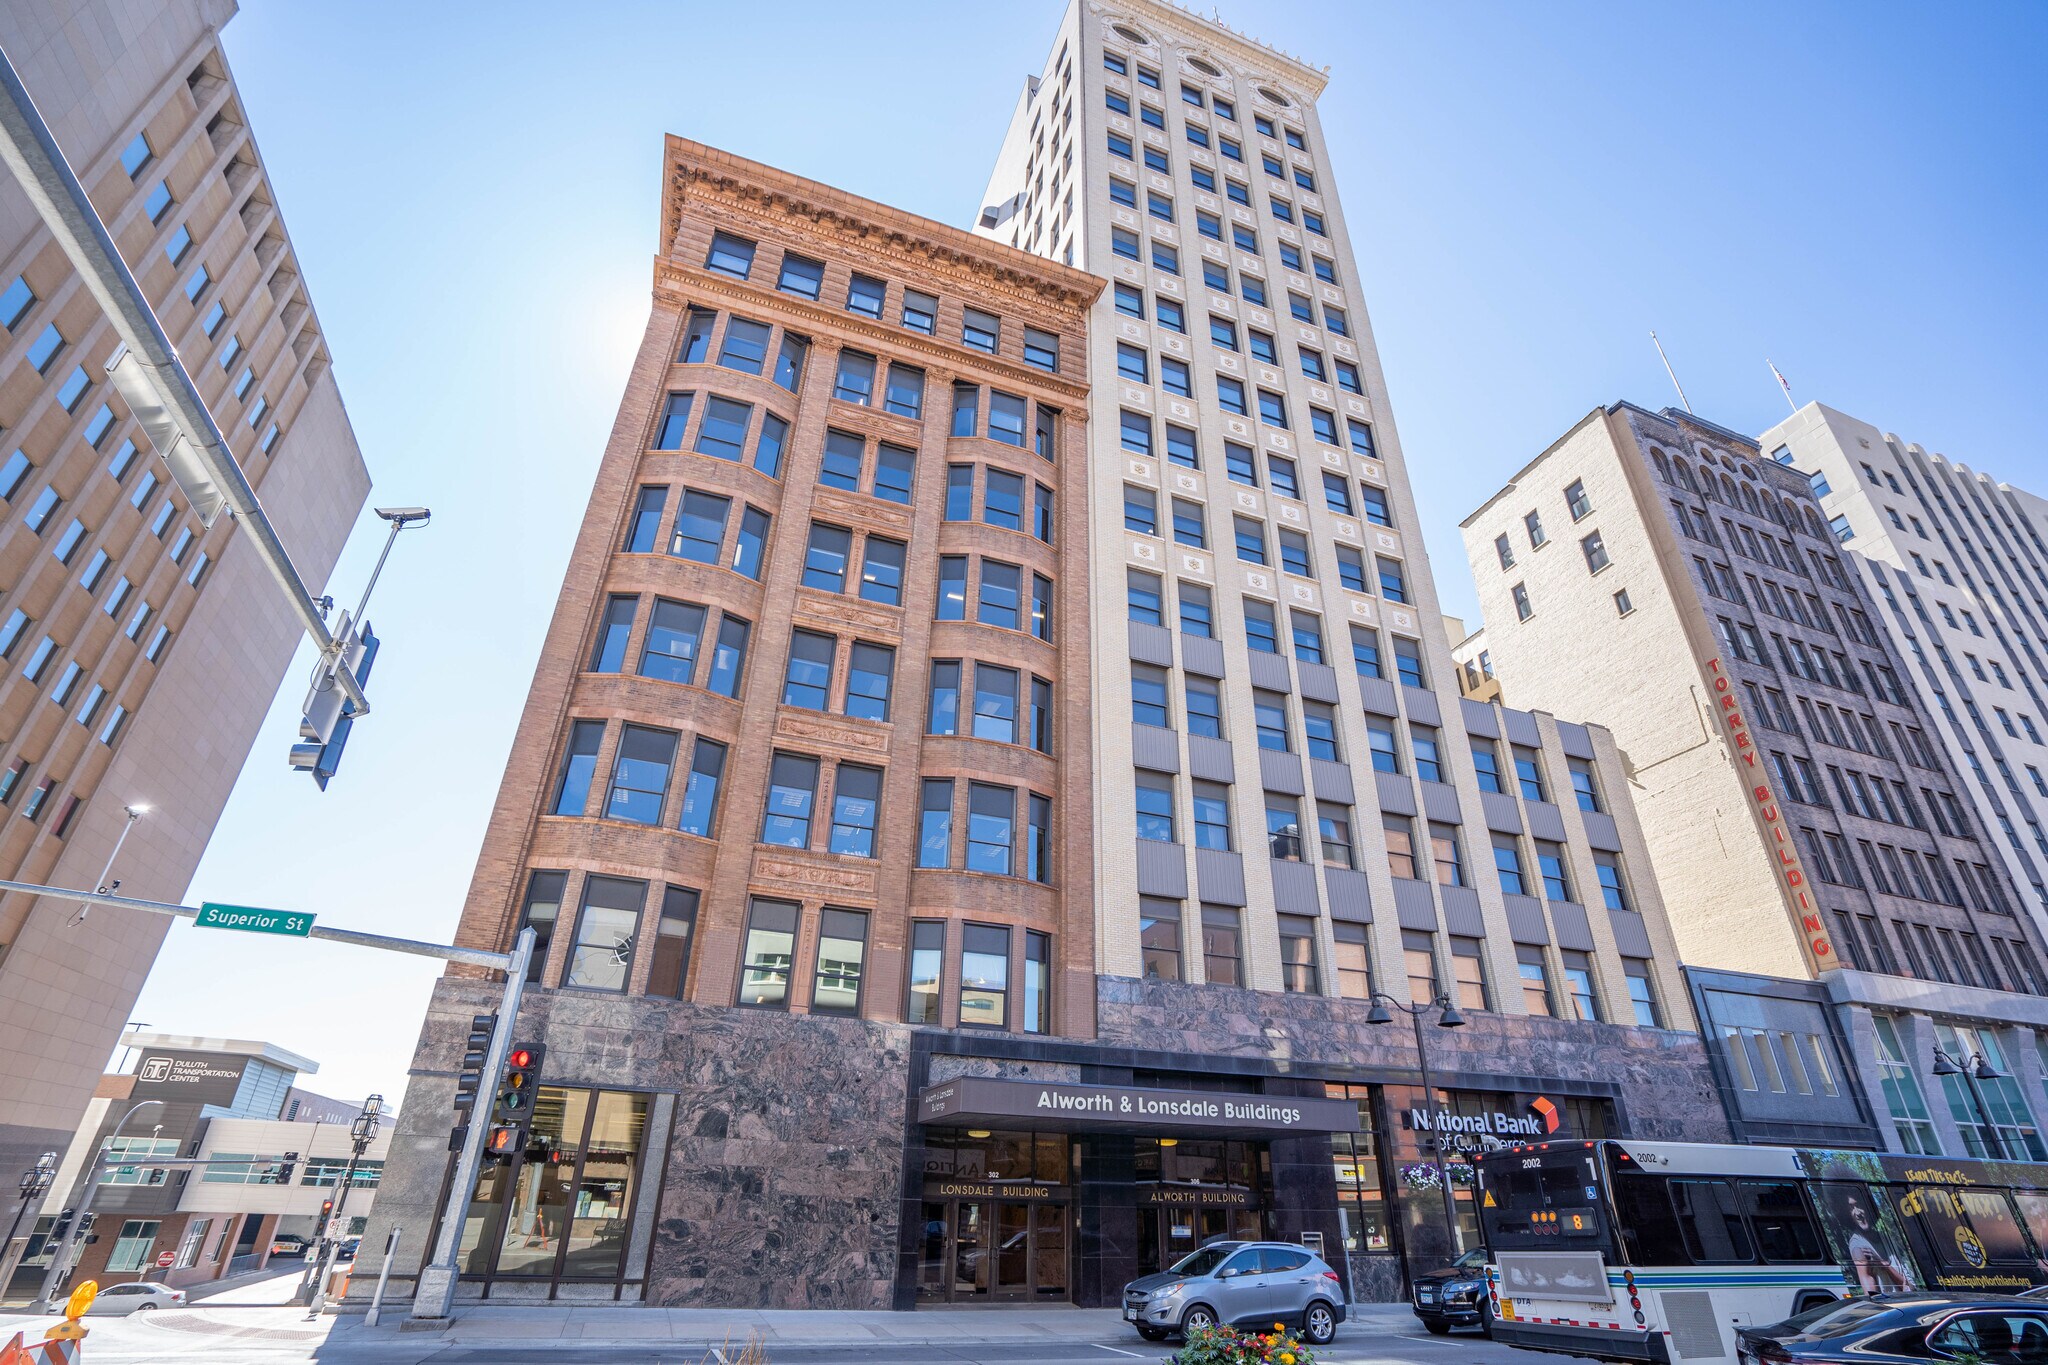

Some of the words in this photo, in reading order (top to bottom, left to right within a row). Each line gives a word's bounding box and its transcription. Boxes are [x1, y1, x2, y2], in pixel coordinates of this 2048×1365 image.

[1707, 657, 1757, 768] TORREY
[1754, 784, 1831, 957] BUILDING
[206, 908, 279, 928] Superior
[285, 917, 305, 931] St
[142, 1060, 171, 1079] DTC
[174, 1060, 209, 1069] DULUTH
[169, 1074, 200, 1083] CENTER
[172, 1067, 240, 1078] TRANSPORTATION
[1037, 1091, 1113, 1112] Alworth
[1119, 1095, 1132, 1113] &
[1138, 1096, 1219, 1118] Lonsdale
[1224, 1102, 1301, 1125] Buildings
[1494, 1112, 1542, 1135] Bank
[1439, 1133, 1453, 1151] of
[1522, 1157, 1542, 1169] 2002
[1636, 1152, 1657, 1164] 2002
[988, 1171, 1000, 1179] 302
[1926, 1168, 1945, 1183] THE
[940, 1184, 994, 1196] LONSDALE
[1002, 1187, 1049, 1197] BUILDING
[1150, 1192, 1196, 1202] ALWORTH
[1202, 1193, 1245, 1203] BUILDING
[1900, 1187, 1929, 1217] GET
[1928, 1187, 1966, 1219] THE
[1572, 1213, 1583, 1230] 8
[1936, 1275, 2032, 1289] HealthEquityNorthland.org
